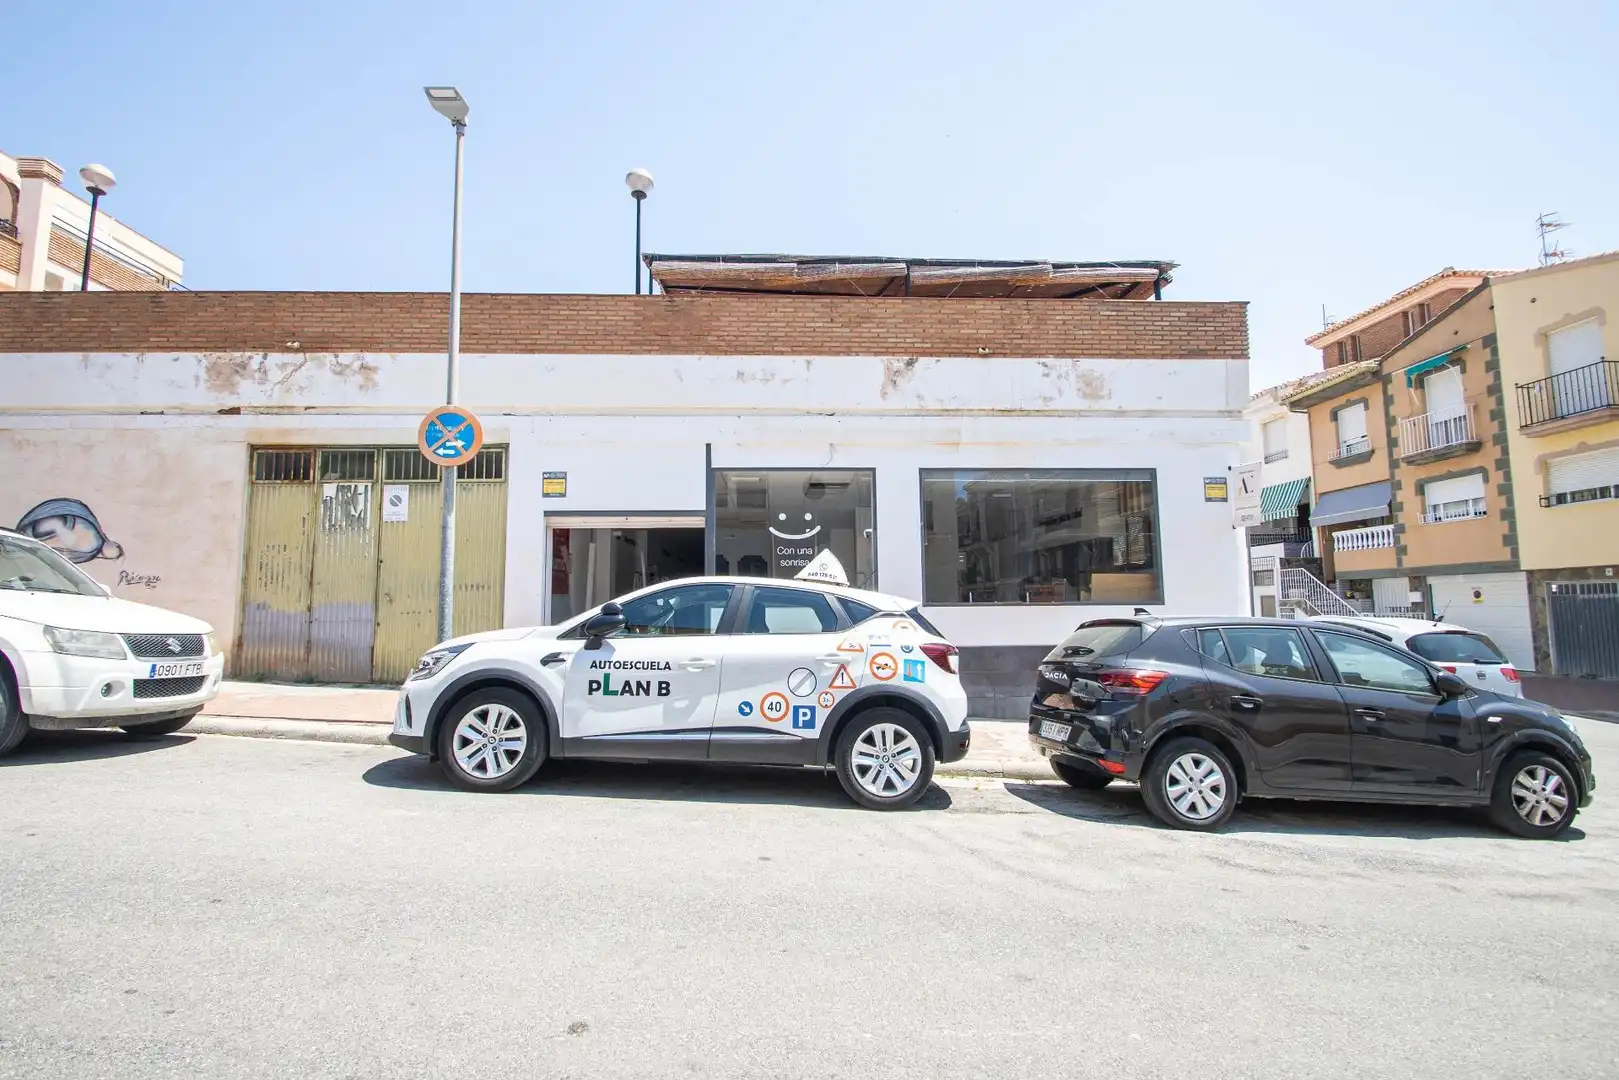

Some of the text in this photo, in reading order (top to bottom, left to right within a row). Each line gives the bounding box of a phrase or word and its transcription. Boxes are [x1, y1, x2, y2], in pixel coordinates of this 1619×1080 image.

[776, 546, 813, 555] Con una
[157, 663, 202, 677] 0901 FTB
[590, 660, 672, 671] AUTOESCUELA
[1044, 672, 1068, 680] DACIA
[588, 673, 671, 697] PLAN B
[767, 701, 782, 713] 40
[798, 708, 812, 727] P
